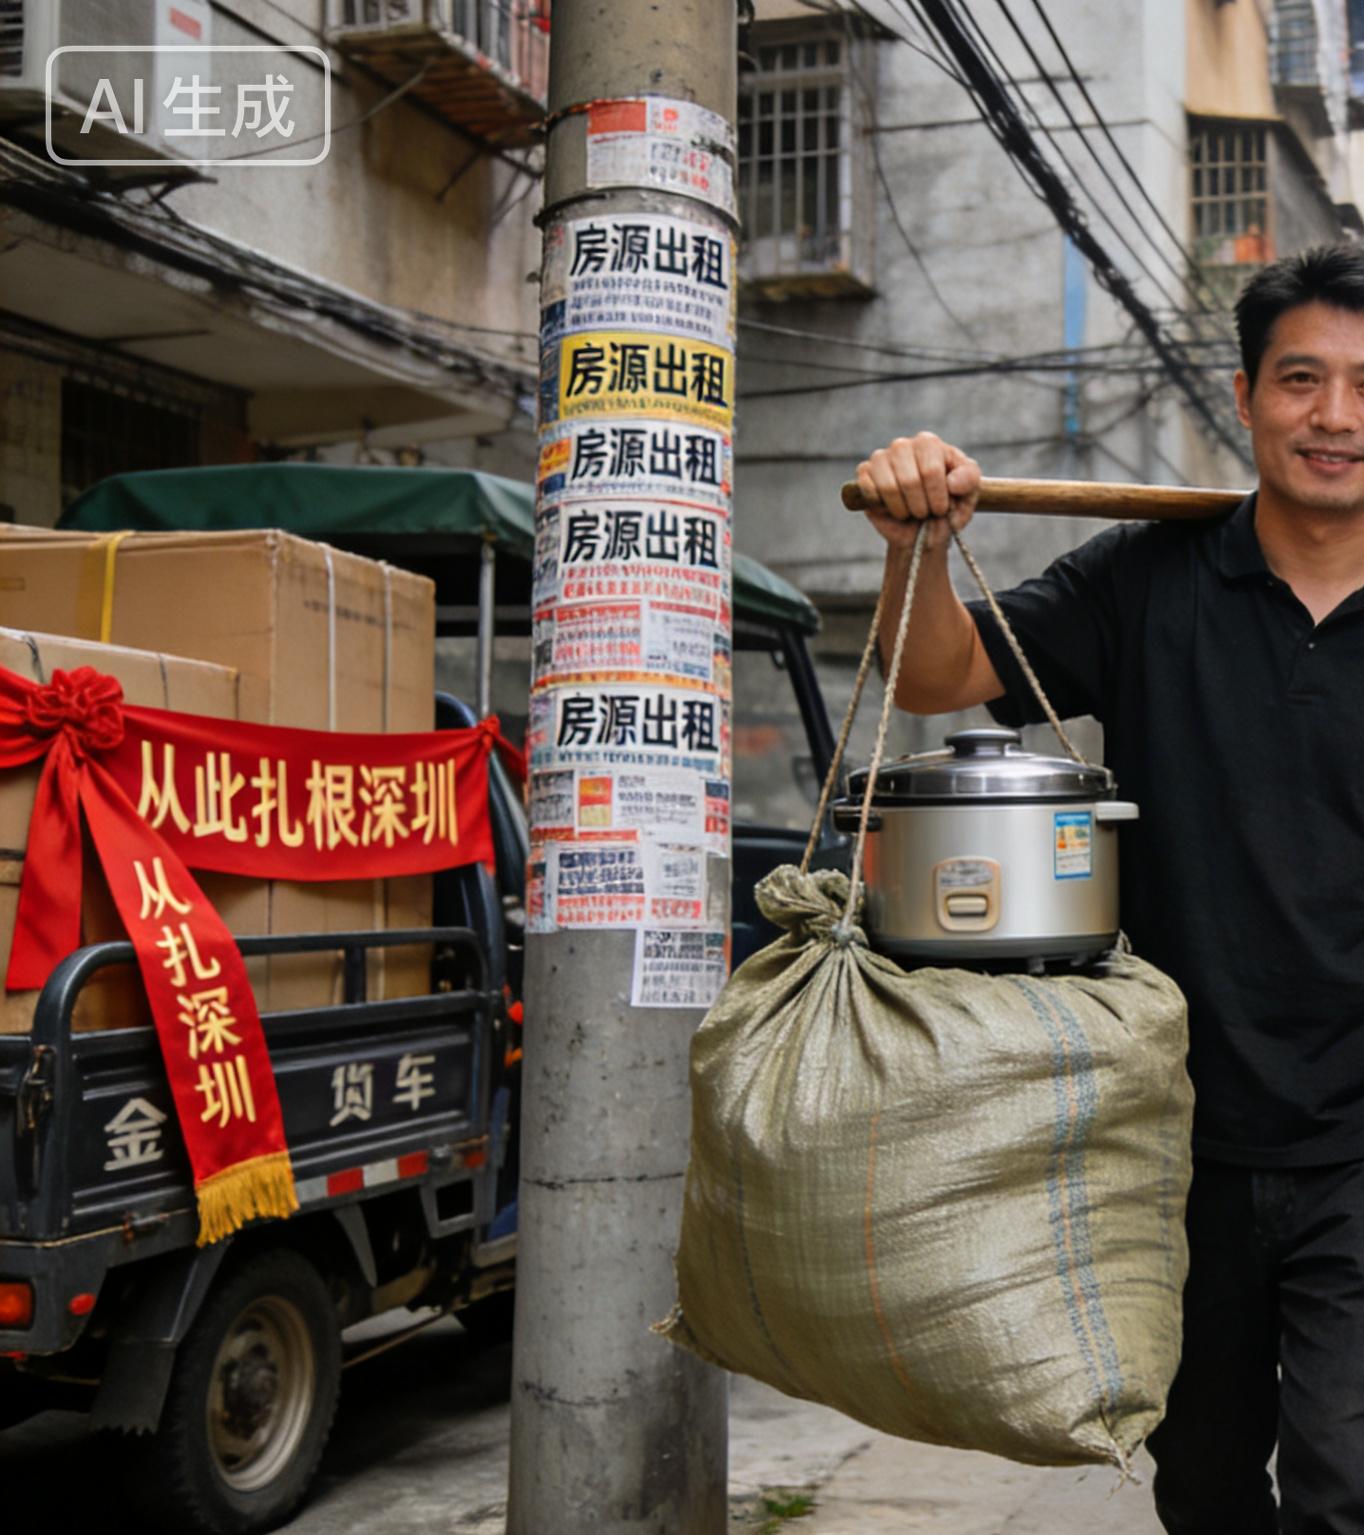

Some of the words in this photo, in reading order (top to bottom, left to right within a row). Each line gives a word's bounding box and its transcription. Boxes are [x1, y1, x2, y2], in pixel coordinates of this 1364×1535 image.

[569, 222, 729, 290] 房源出租
[566, 342, 728, 408] 房源出租
[570, 428, 721, 487] 房源出租
[563, 509, 719, 568] 房源出租
[557, 692, 719, 753] 房源出租
[136, 740, 459, 850] 从此扎根深圳
[132, 856, 256, 1128] 从扎深圳
[103, 1097, 168, 1171] 金
